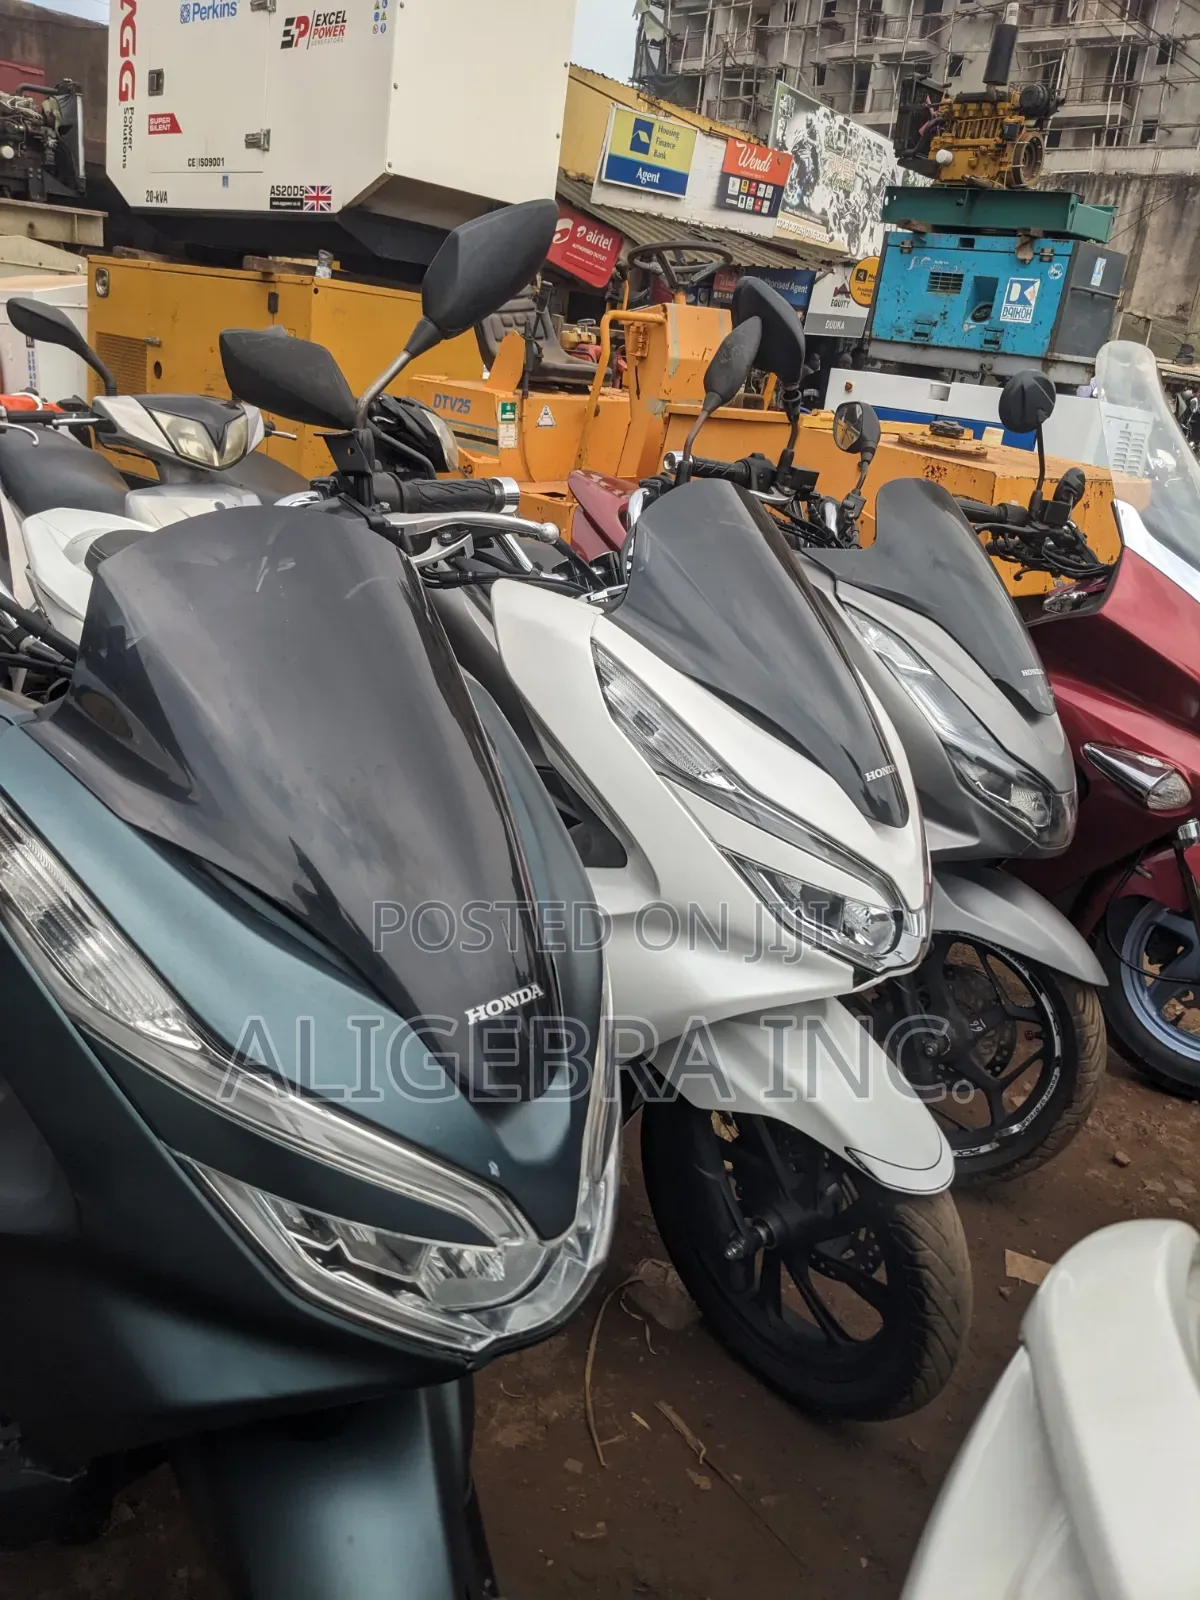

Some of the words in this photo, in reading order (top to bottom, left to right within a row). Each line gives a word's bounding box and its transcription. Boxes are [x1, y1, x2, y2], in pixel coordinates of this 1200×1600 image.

[192, 0, 237, 22] Perkins
[315, 10, 347, 26] EXCEL
[312, 24, 346, 39] POWER
[658, 125, 680, 141] Housing
[655, 137, 676, 150] Finance
[653, 149, 666, 160] Bank
[736, 141, 773, 173] Wendi
[636, 167, 660, 184] Agent
[145, 190, 168, 204] 20-kVA
[270, 185, 304, 197] AS20D5
[586, 230, 613, 251] airtel
[790, 282, 808, 294] Agent
[830, 299, 850, 309] EQUITY
[433, 393, 472, 414] DTV25
[464, 983, 545, 1026] HONDA
